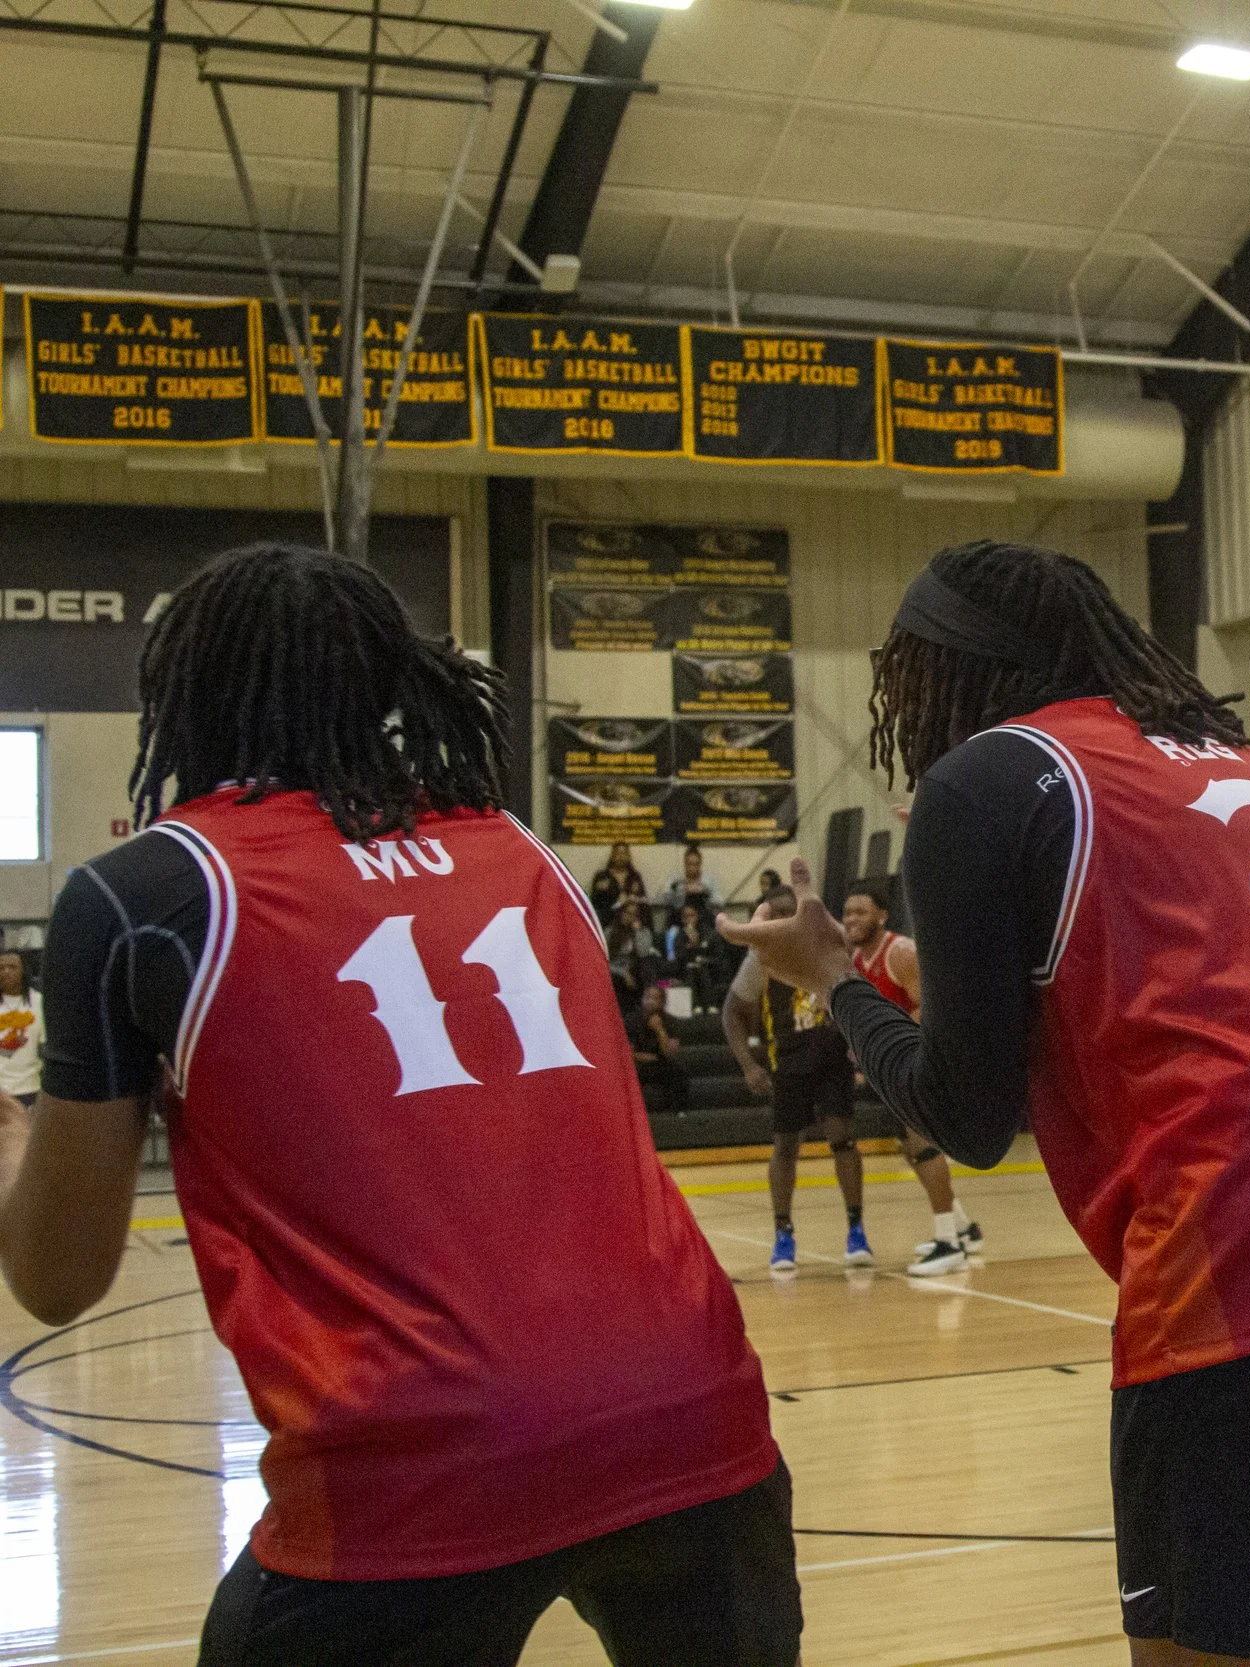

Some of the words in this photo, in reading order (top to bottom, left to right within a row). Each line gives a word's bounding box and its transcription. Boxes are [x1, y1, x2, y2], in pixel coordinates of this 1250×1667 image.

[117, 344, 243, 368] BASKETBALL
[37, 371, 149, 397] TOURNAMENT
[156, 376, 247, 399] CHAMPIONS
[563, 358, 677, 384] BASKETBALL
[710, 360, 859, 388] CHAMPIONS
[493, 386, 592, 410] TOURNAMENT
[598, 390, 681, 413] CHAMPIONS
[112, 406, 172, 429] 2016
[0, 588, 124, 622] DER
[340, 837, 454, 884] MU
[336, 906, 596, 1097] 11
